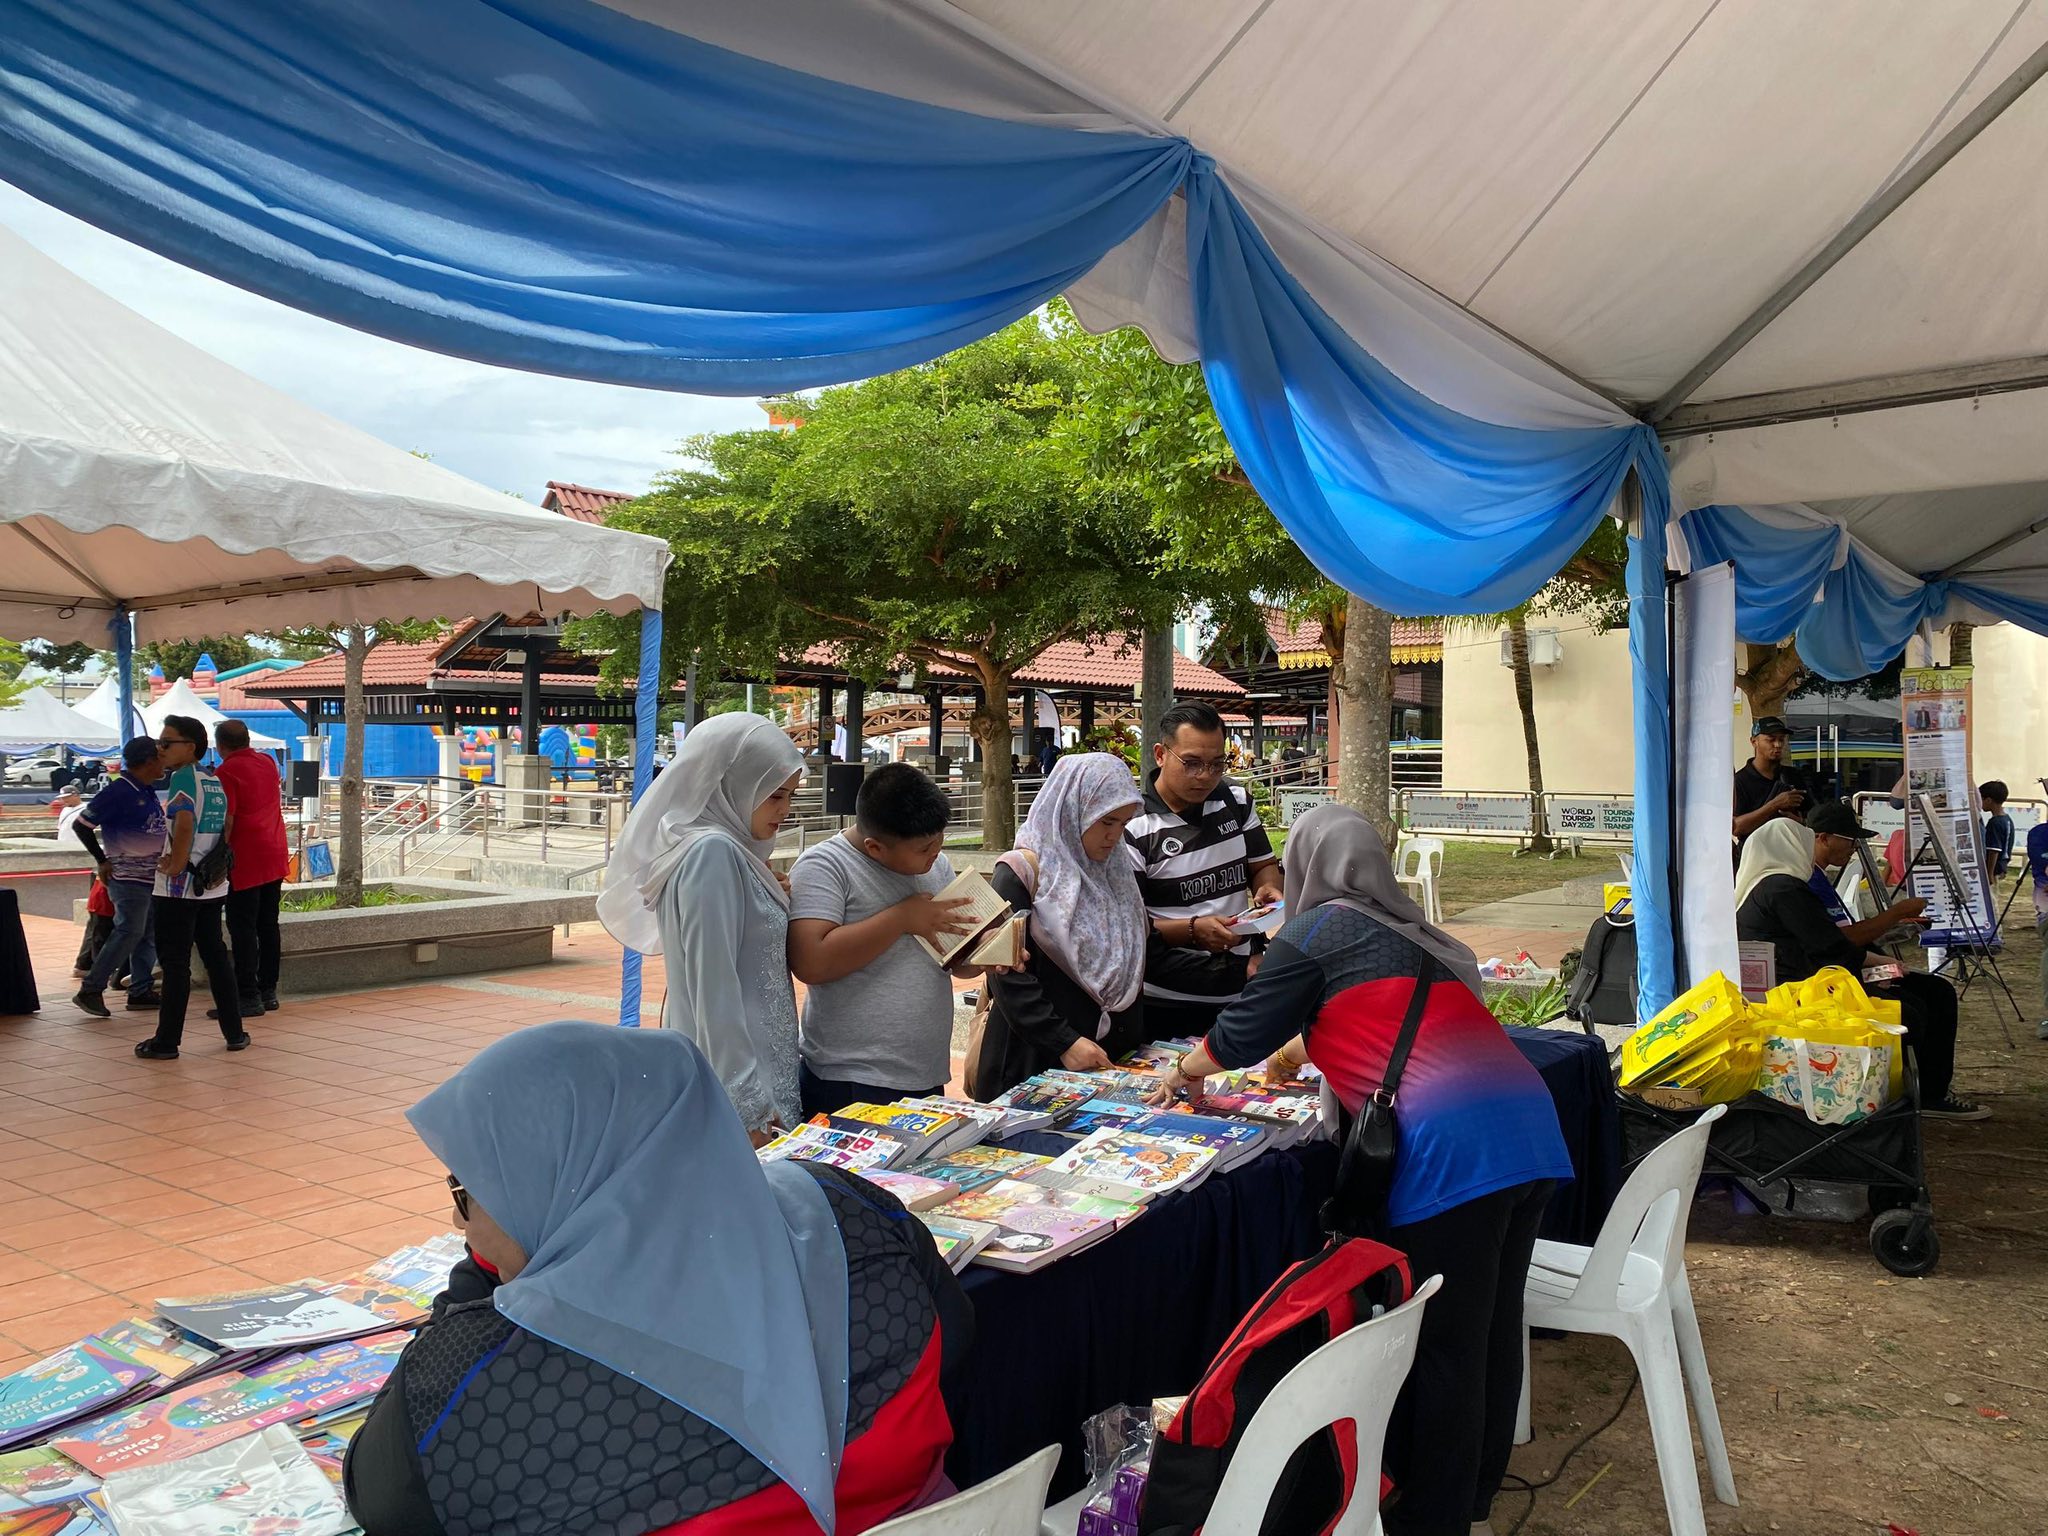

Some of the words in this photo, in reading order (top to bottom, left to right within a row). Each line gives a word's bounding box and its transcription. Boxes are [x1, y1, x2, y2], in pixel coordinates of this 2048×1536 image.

[1561, 807, 1593, 815] WORLD
[1180, 873, 1216, 901] KOPI
[1217, 863, 1247, 890] JAIL
[232, 1397, 278, 1416] John
[95, 1433, 166, 1464] Some?
[134, 1442, 162, 1457] All
[115, 1453, 131, 1463] or
